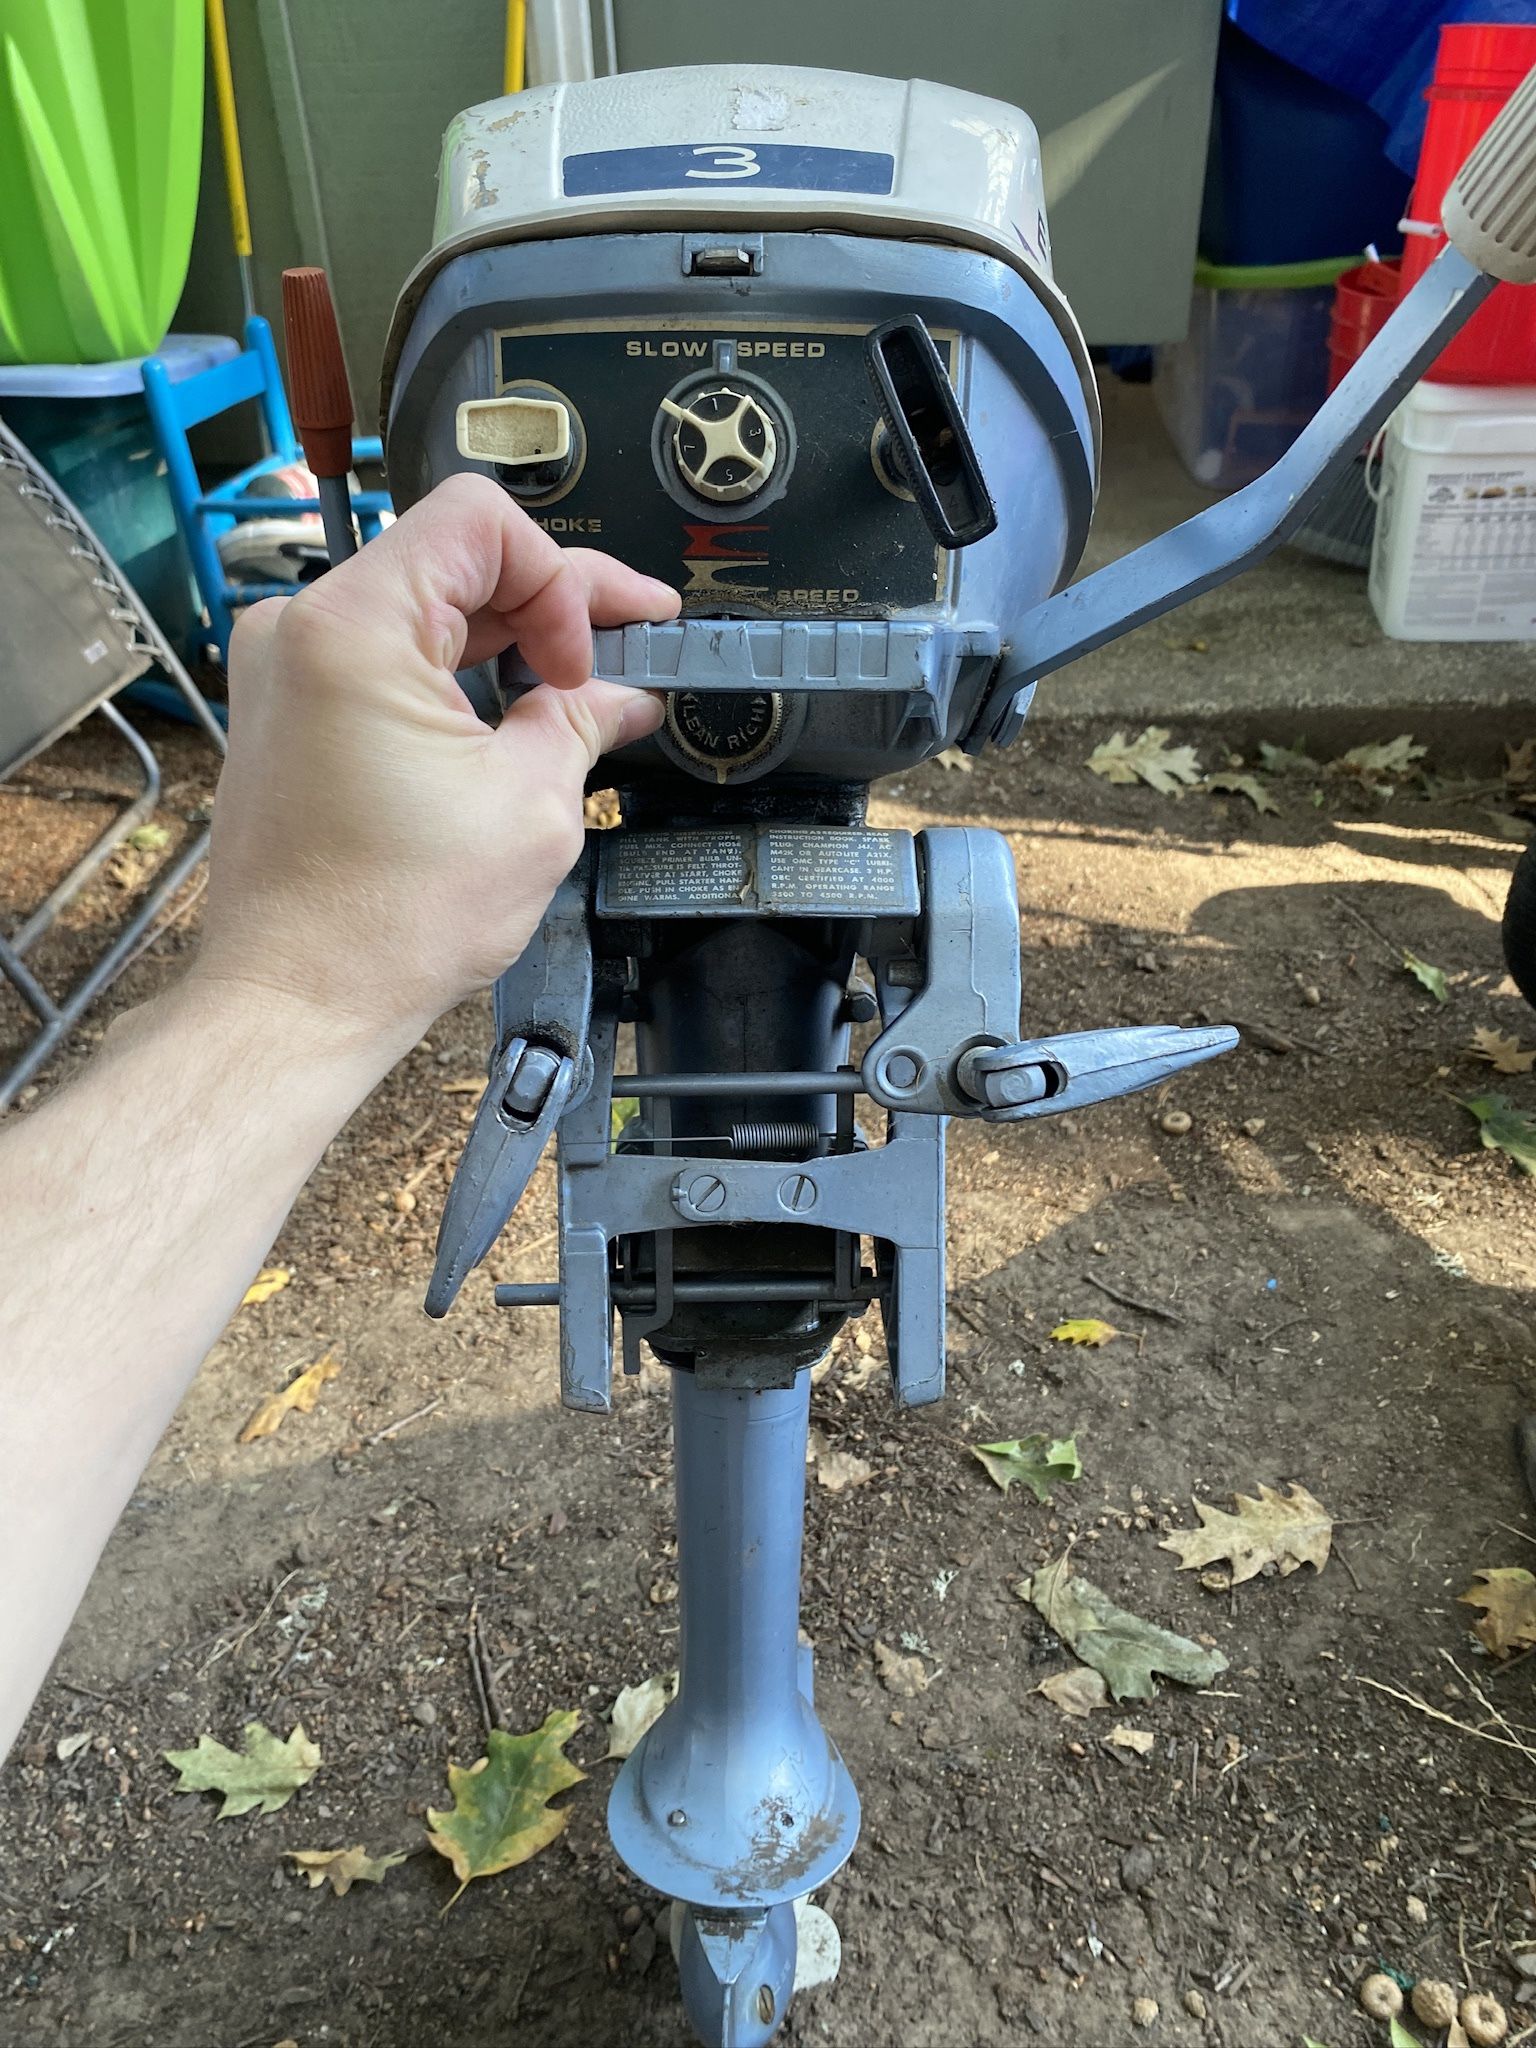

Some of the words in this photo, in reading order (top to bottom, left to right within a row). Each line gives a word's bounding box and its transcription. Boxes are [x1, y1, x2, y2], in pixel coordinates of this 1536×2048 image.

[684, 145, 762, 179] 3
[625, 341, 708, 358] SLOW
[737, 342, 826, 358] SPEED
[750, 428, 762, 437] 3
[725, 468, 734, 482] 5
[532, 517, 602, 533] HOKE
[776, 589, 860, 603] SPEED
[681, 704, 721, 748] LEAN
[727, 706, 766, 750] RICH
